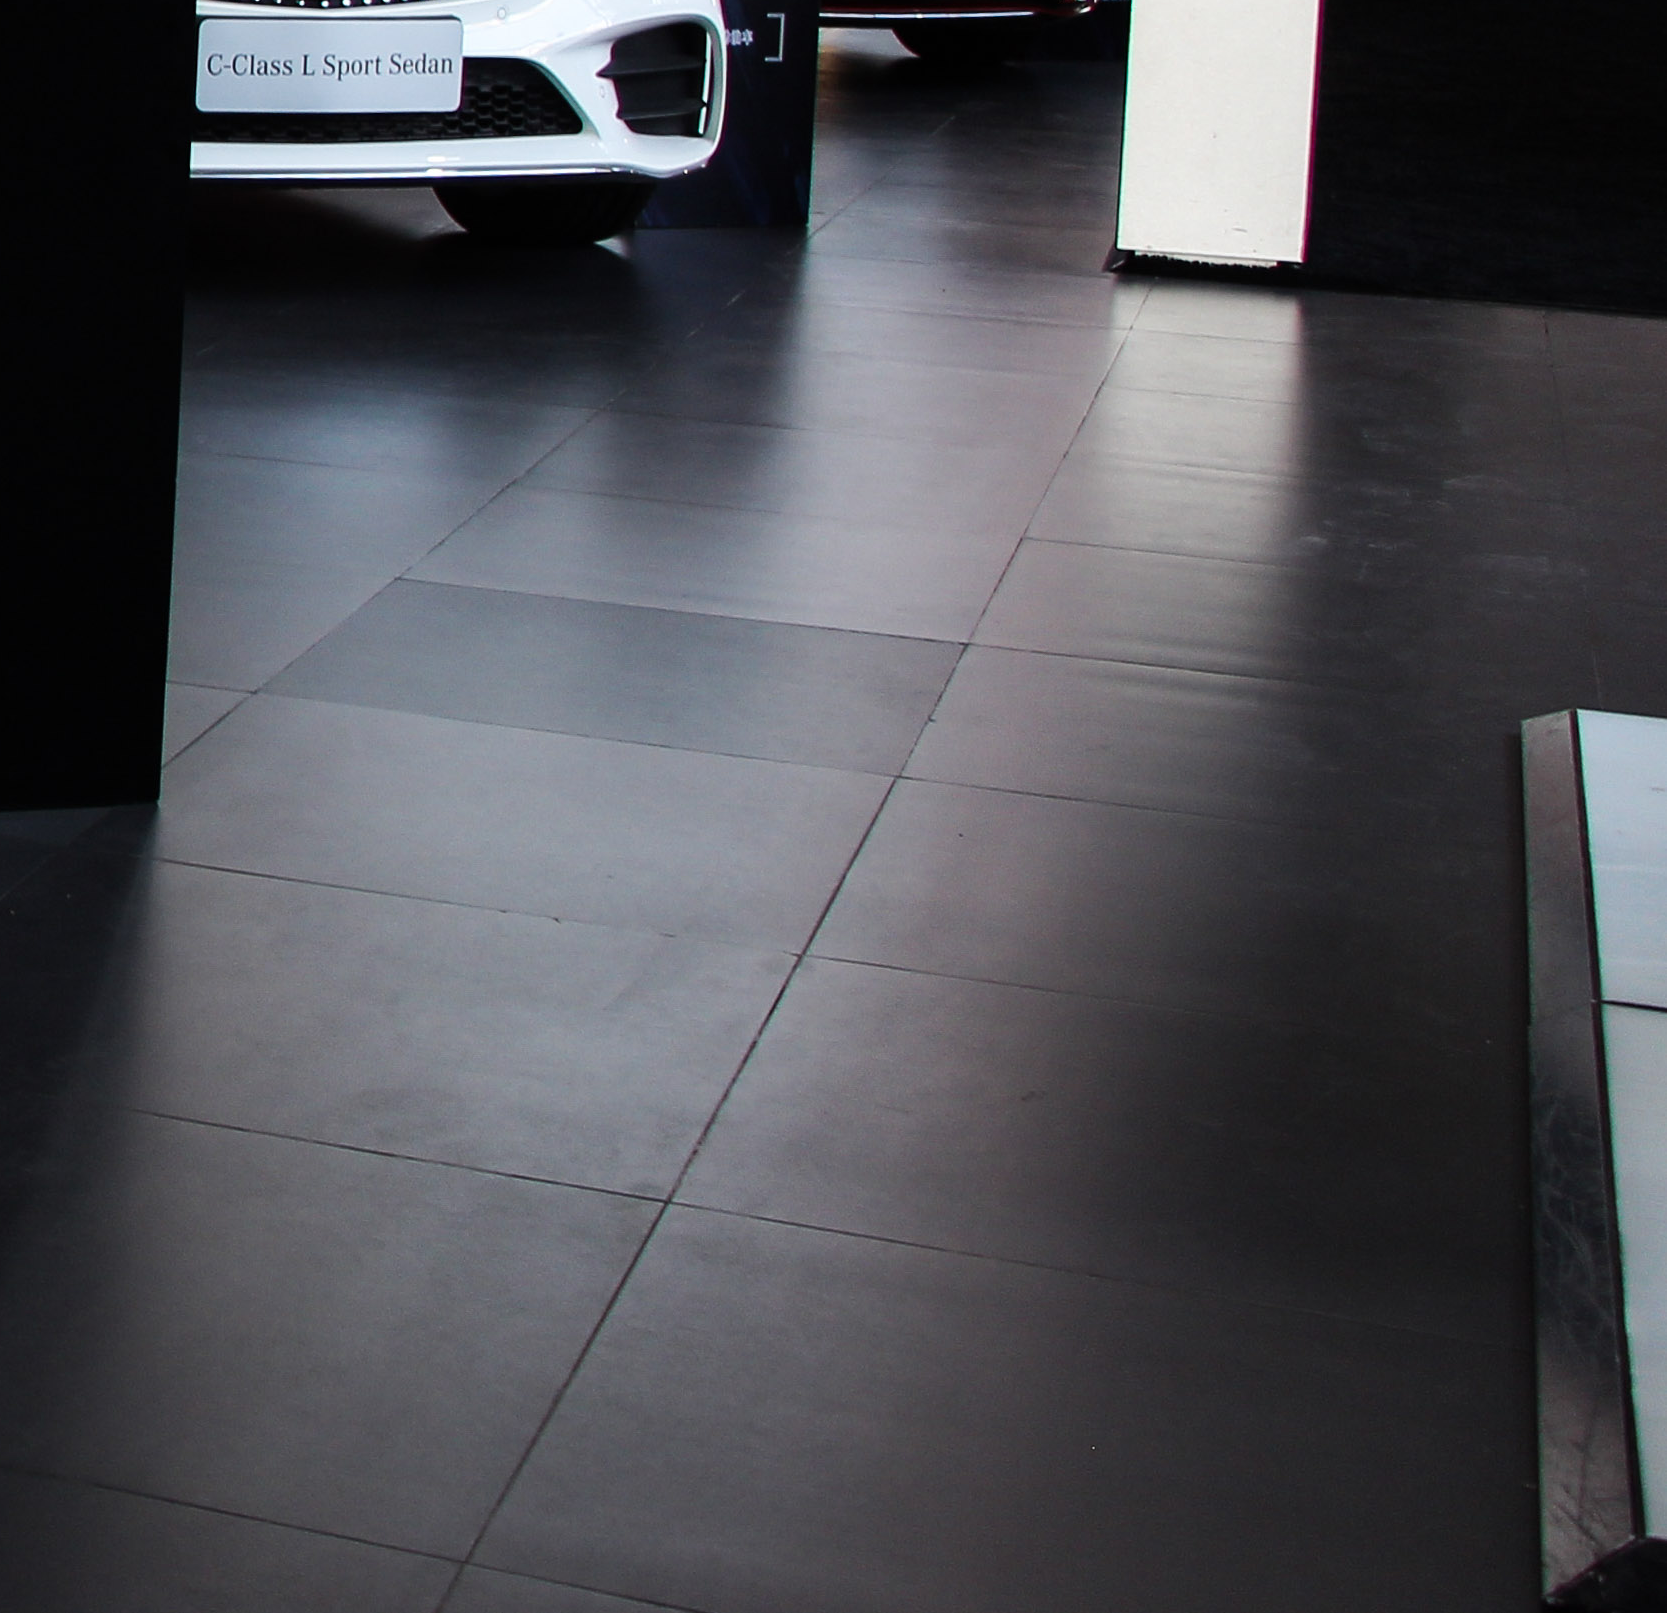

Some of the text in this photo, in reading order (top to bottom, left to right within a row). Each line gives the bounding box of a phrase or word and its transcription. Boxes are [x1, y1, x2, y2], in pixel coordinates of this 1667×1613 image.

[206, 52, 454, 81] C-Class L Sport Sedan
